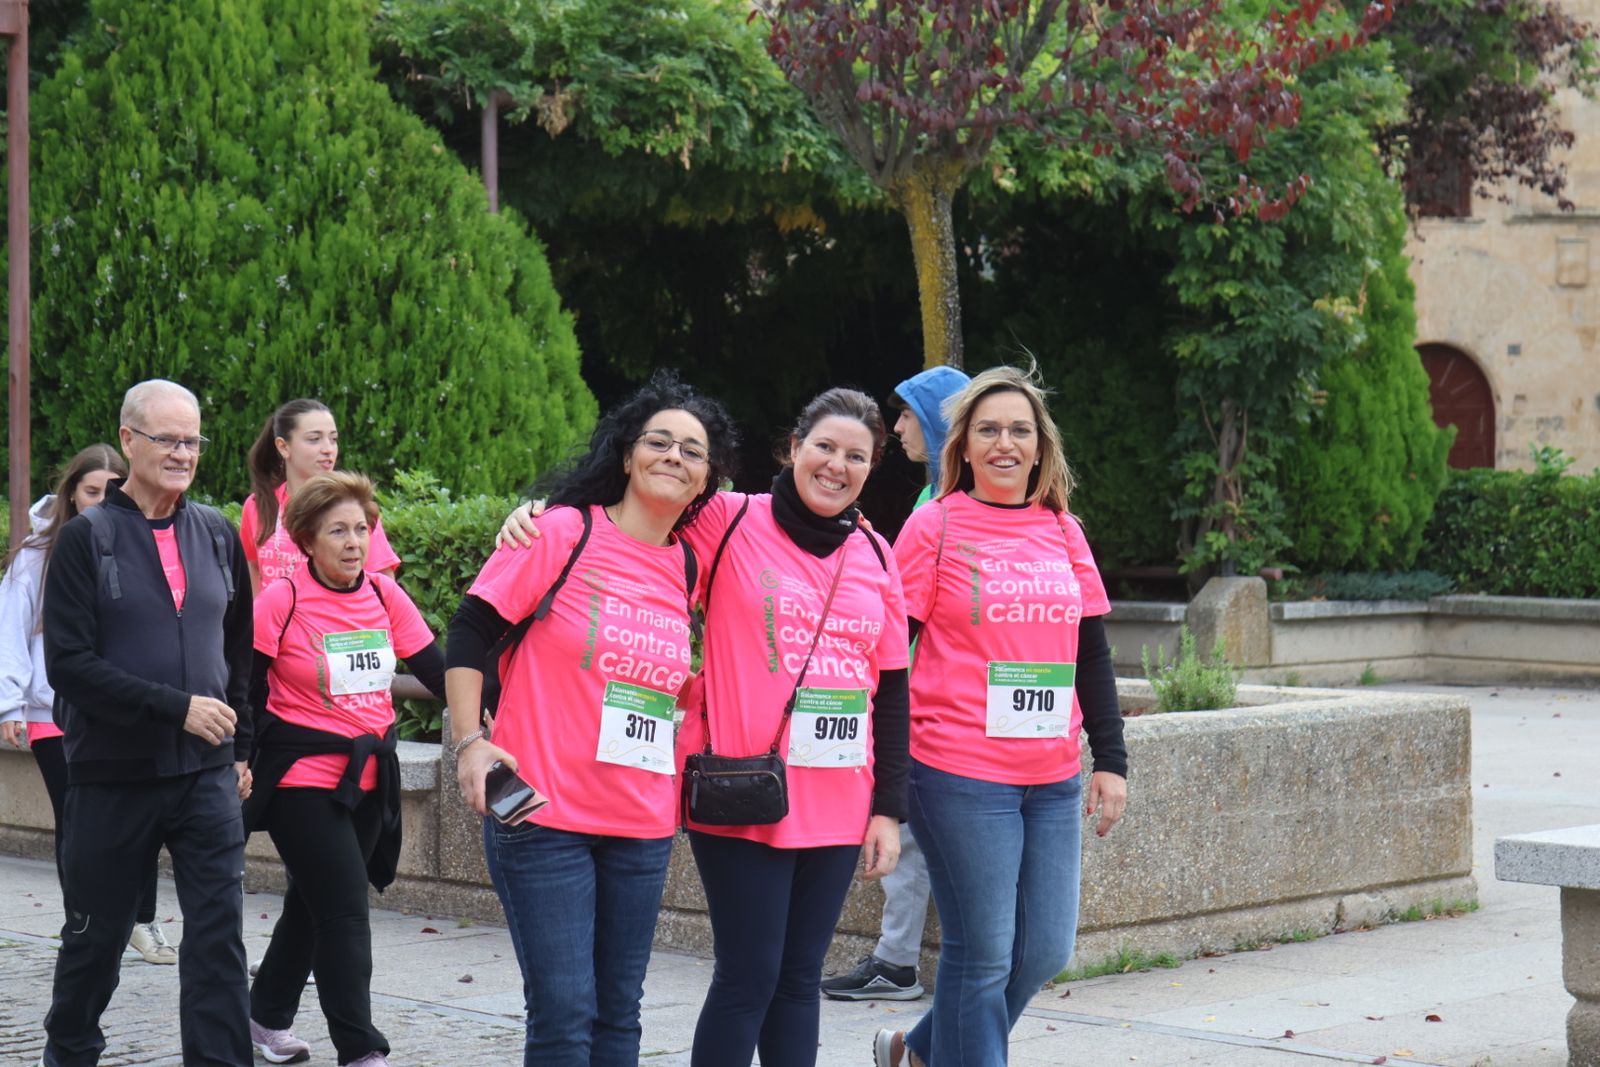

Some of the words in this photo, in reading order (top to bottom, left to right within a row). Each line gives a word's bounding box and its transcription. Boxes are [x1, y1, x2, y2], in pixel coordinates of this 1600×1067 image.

[981, 558, 1009, 572] En
[985, 575, 1068, 596] contra
[604, 595, 632, 619] En
[780, 596, 806, 619] En
[986, 596, 1083, 625] cánce
[603, 624, 678, 660] contra
[764, 595, 779, 674] SALAMANCA
[346, 652, 380, 672] 7415
[598, 648, 688, 691] cánce
[1013, 689, 1054, 712] 9710
[625, 713, 656, 743] 3717
[815, 716, 858, 740] 9709
